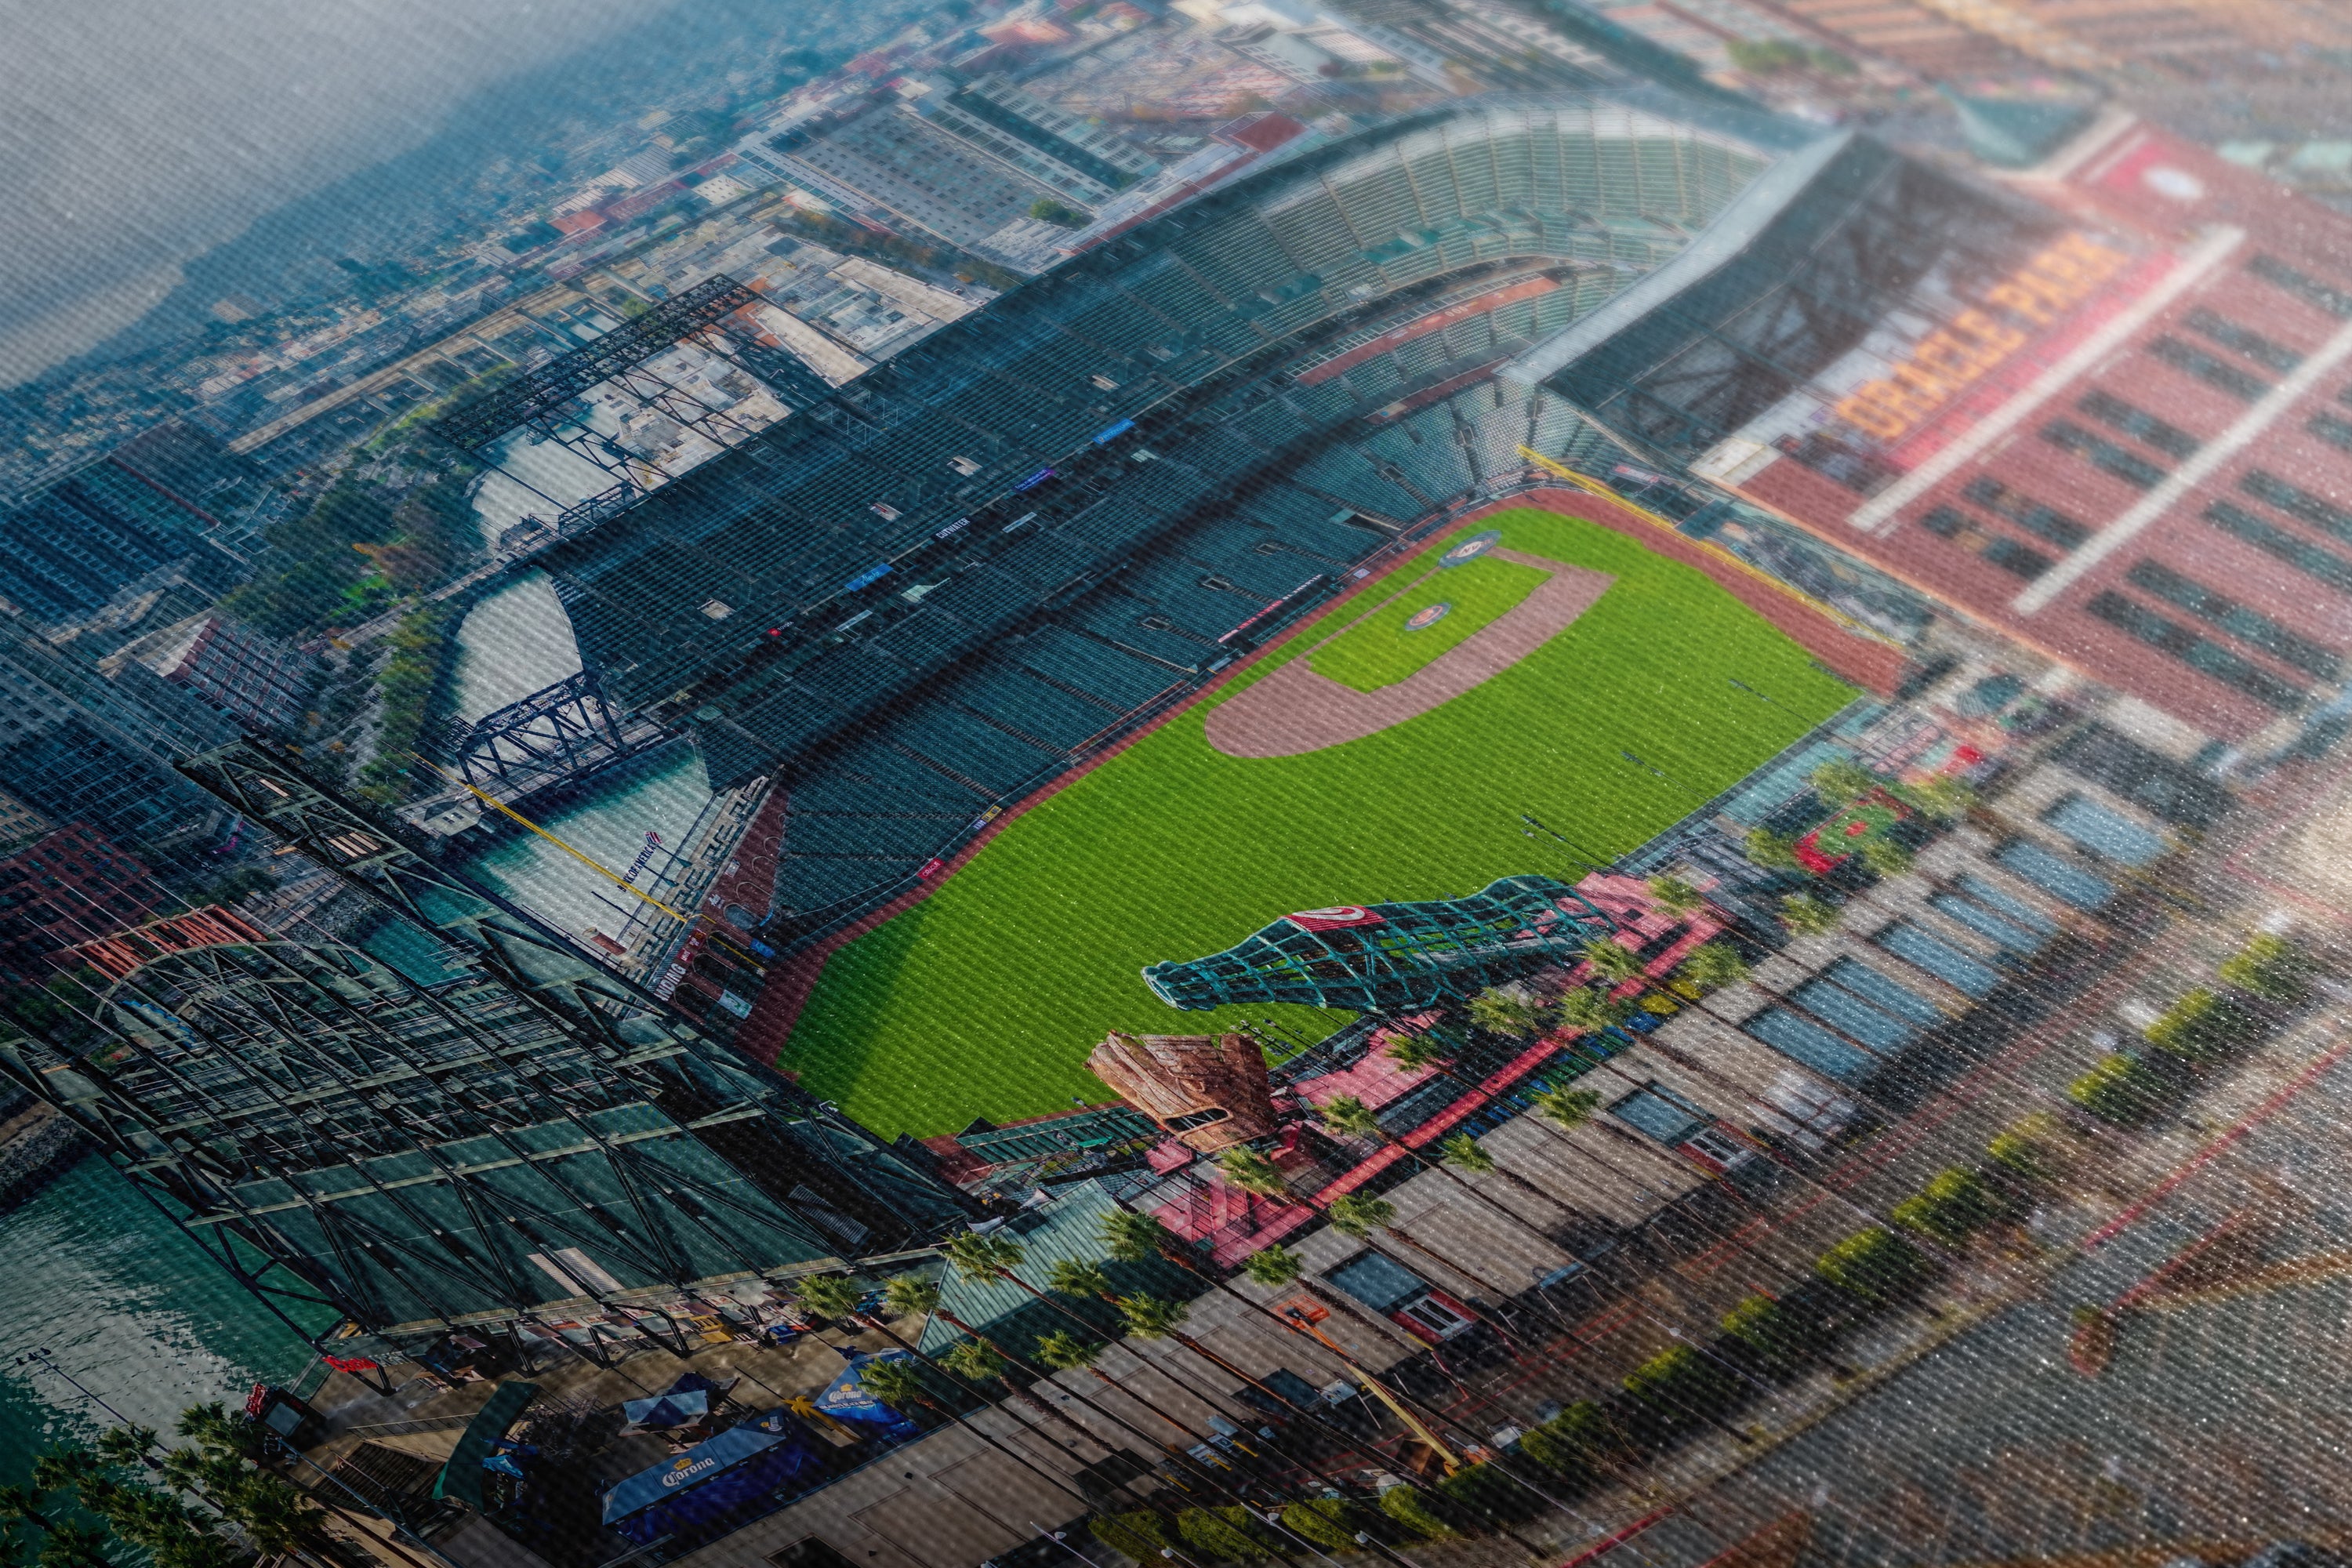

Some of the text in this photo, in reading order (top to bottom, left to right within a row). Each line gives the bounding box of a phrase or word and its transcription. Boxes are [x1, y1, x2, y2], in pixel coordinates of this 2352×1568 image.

[1835, 230, 2132, 438] ORACLE PARK
[935, 517, 971, 539] CUTWATER
[617, 873, 635, 892] BNK
[828, 1389, 862, 1403] Corona
[661, 1457, 715, 1487] Corona
